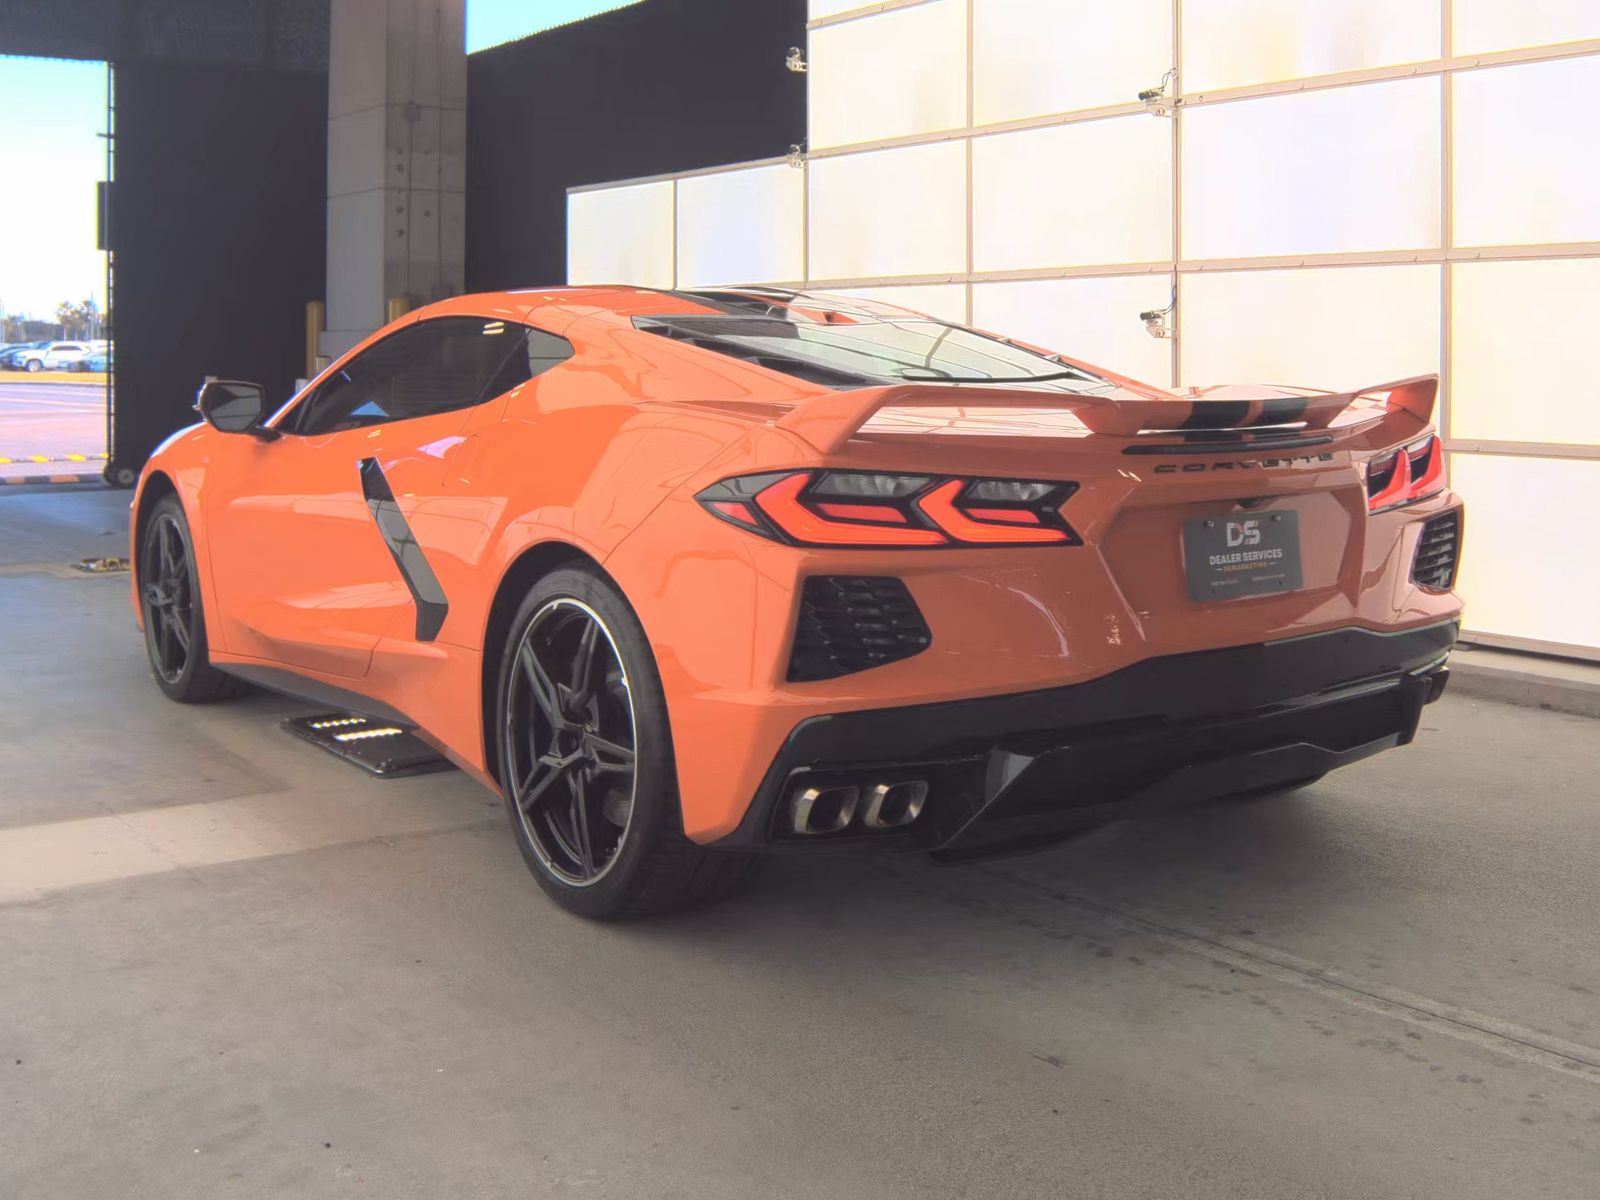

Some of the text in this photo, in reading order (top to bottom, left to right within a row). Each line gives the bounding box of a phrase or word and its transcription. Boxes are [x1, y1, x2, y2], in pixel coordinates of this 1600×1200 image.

[1154, 452, 1333, 474] CORVETTE
[1226, 520, 1261, 547] DS
[1209, 548, 1283, 566] DEALER SERVICES
